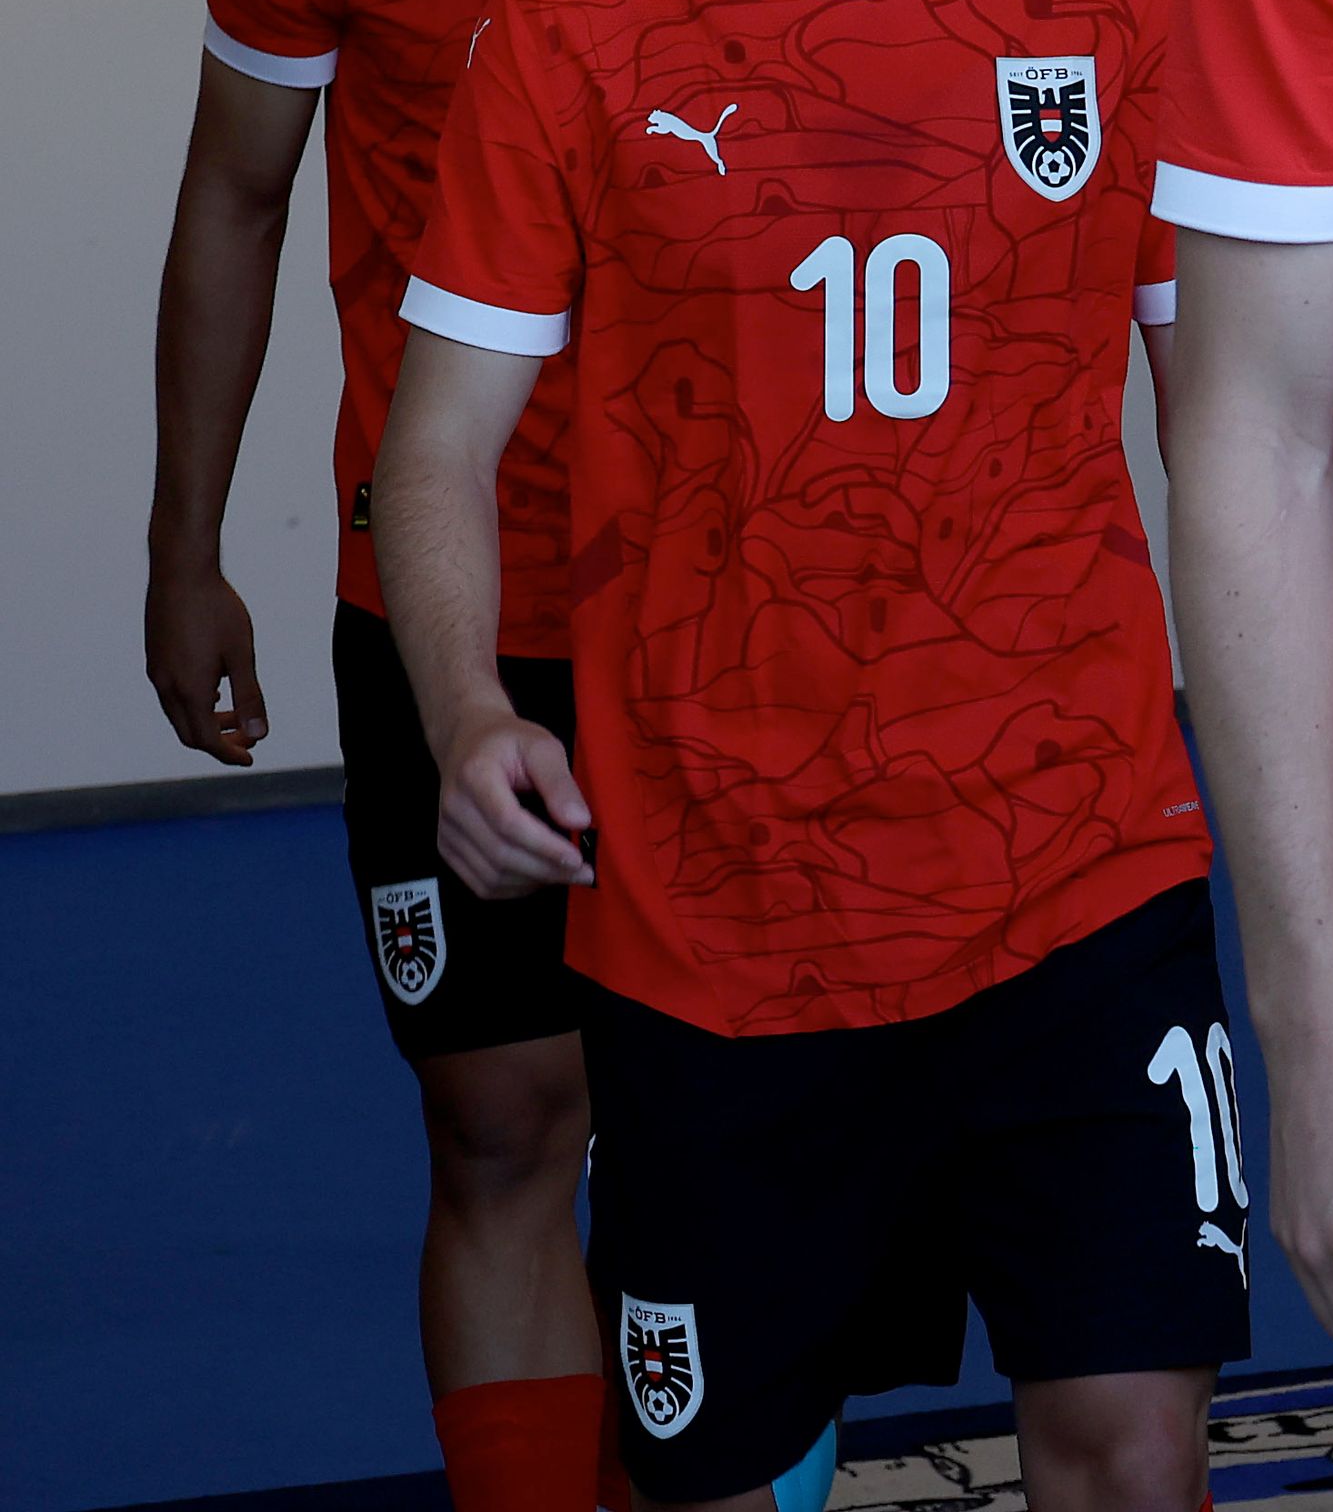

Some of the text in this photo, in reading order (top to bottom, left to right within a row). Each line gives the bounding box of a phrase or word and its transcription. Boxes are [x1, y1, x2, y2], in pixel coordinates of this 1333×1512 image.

[1025, 66, 1069, 80] ÖFB
[789, 233, 950, 422] 10
[1147, 1021, 1249, 1213] 10
[635, 1306, 666, 1324] ÖFB
